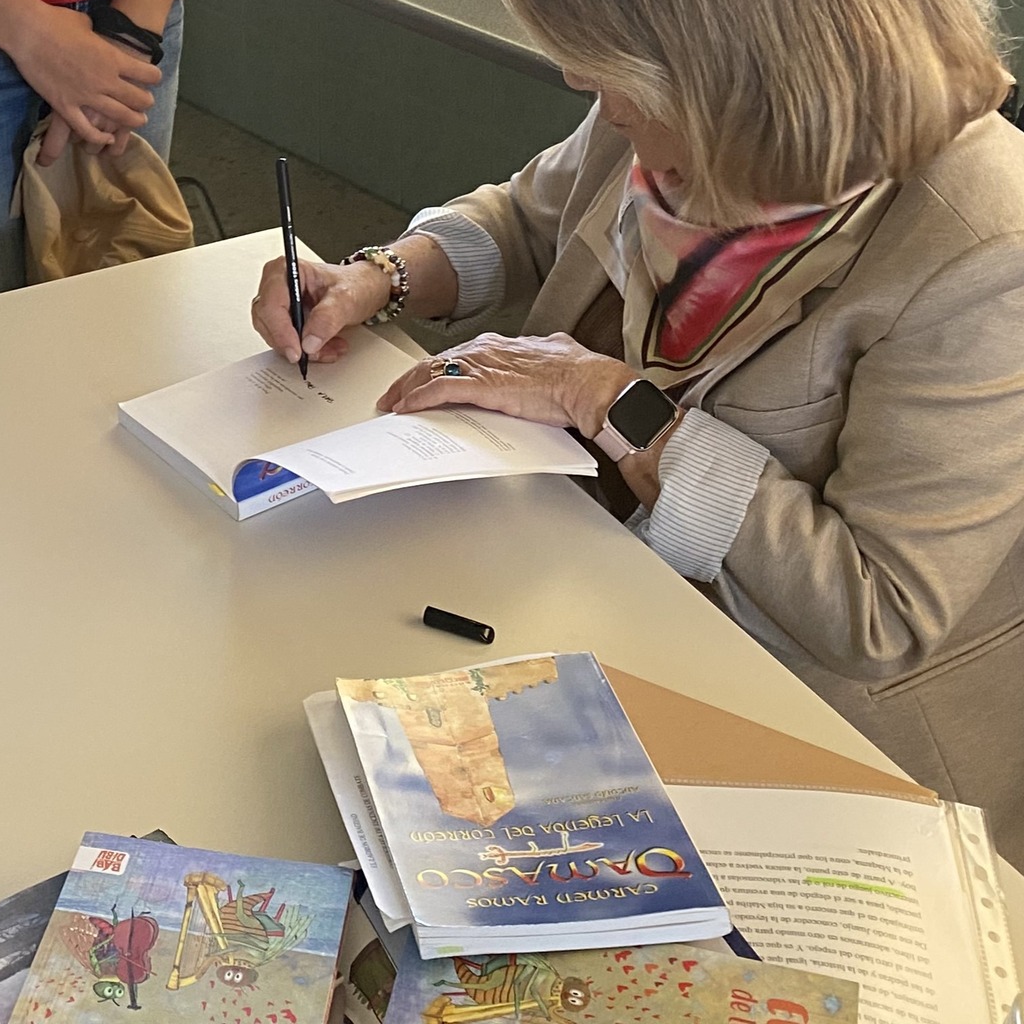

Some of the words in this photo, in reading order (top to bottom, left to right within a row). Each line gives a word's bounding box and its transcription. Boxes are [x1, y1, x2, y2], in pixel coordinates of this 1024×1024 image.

[268, 480, 315, 503] ORREÓN
[626, 809, 653, 824] LA
[539, 814, 623, 834] LEYENDA
[409, 828, 495, 843] TORREÓN
[500, 825, 534, 840] DEL
[416, 847, 693, 890] DAMASCO
[864, 875, 886, 883] partir
[556, 883, 658, 904] CARMEN
[464, 894, 548, 908] RAMOS
[794, 918, 838, 927] conocedor
[872, 930, 897, 940] modo
[840, 937, 890, 952] adentrarnos
[786, 958, 807, 966] igual
[854, 954, 874, 965] lado
[875, 958, 893, 968] otro
[857, 968, 868, 977] de
